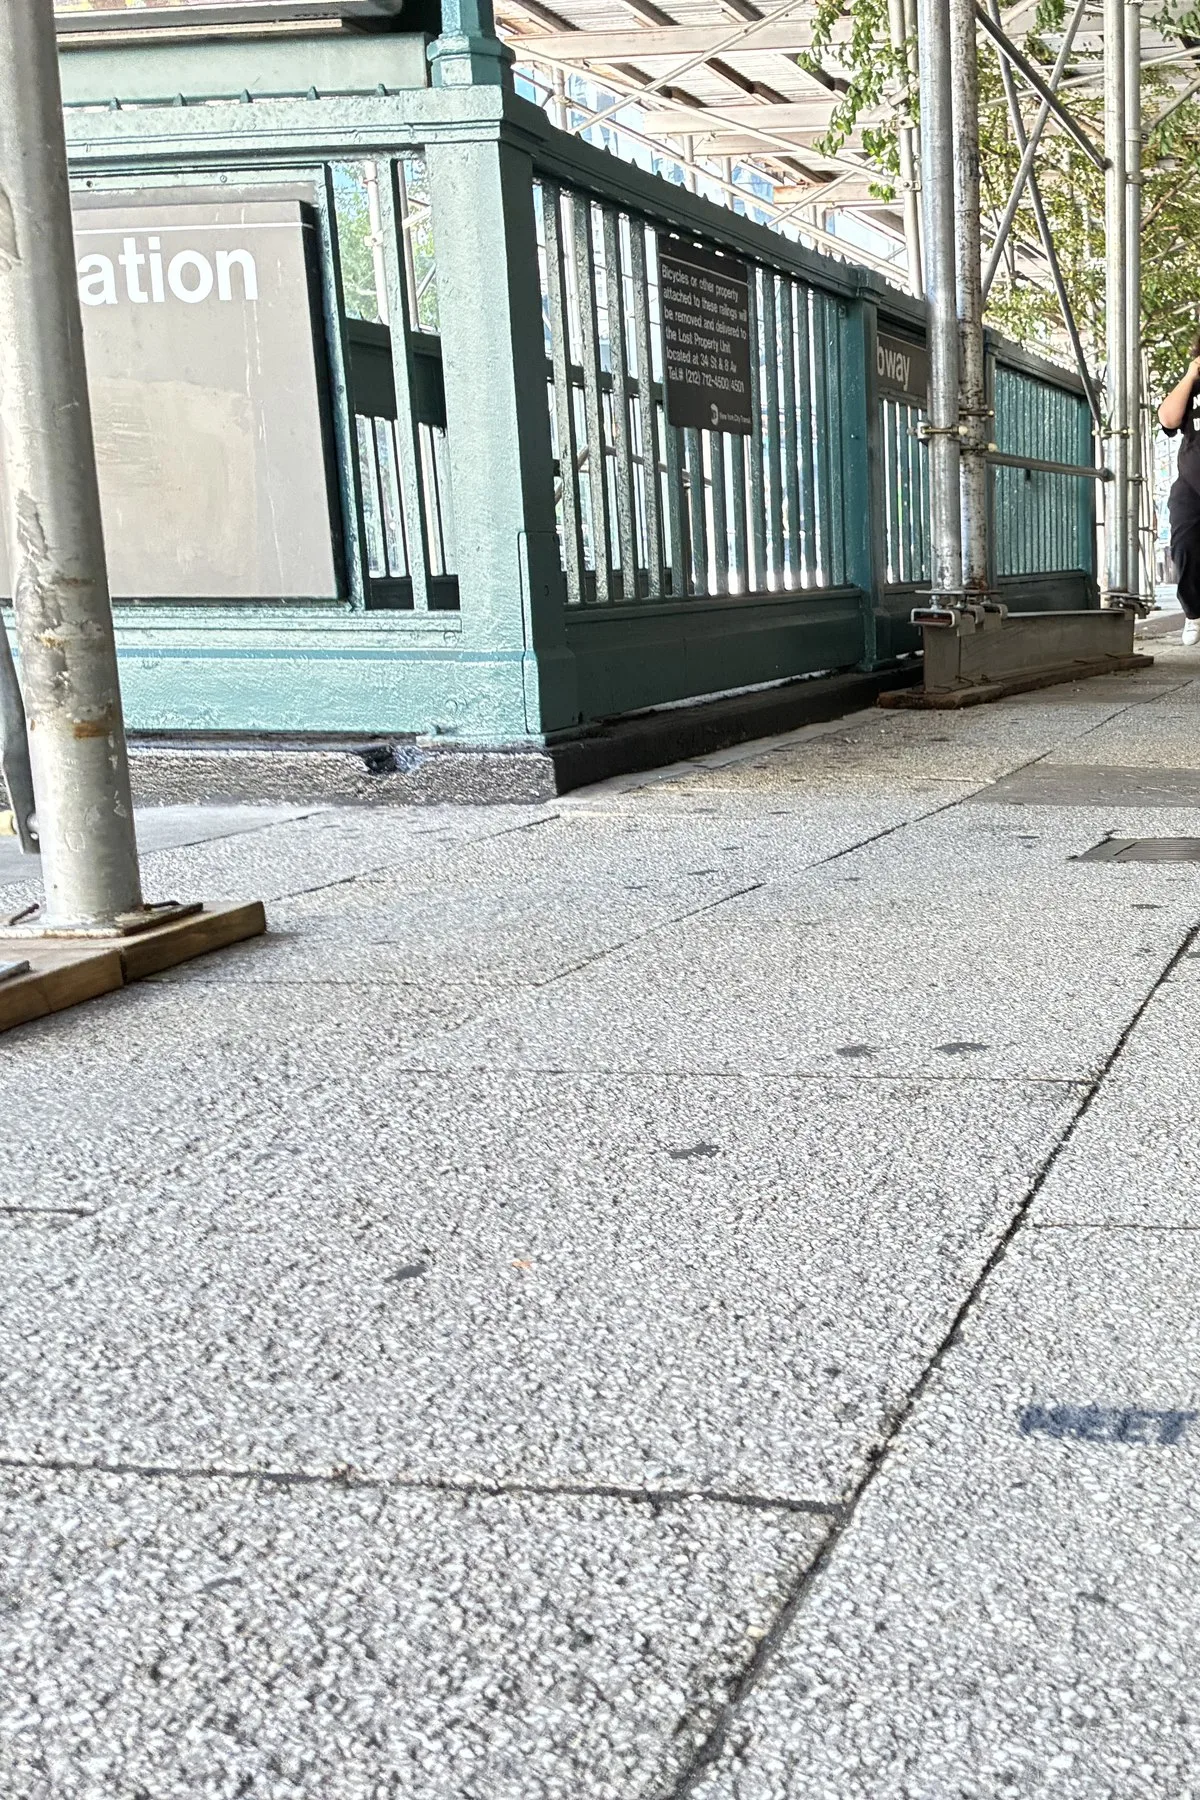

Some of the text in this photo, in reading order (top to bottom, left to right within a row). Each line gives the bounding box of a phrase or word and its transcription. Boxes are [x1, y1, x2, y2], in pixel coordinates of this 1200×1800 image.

[77, 237, 258, 306] ation
[661, 263, 738, 303] Bicycles or other property
[663, 287, 747, 321] attached to these railings will
[664, 305, 746, 340] be removed and delivered to
[665, 326, 731, 353] the Lost Property Unit
[666, 346, 737, 373] located at 34 St & 8 Av
[685, 368, 701, 385] (212)
[877, 336, 910, 392] bway
